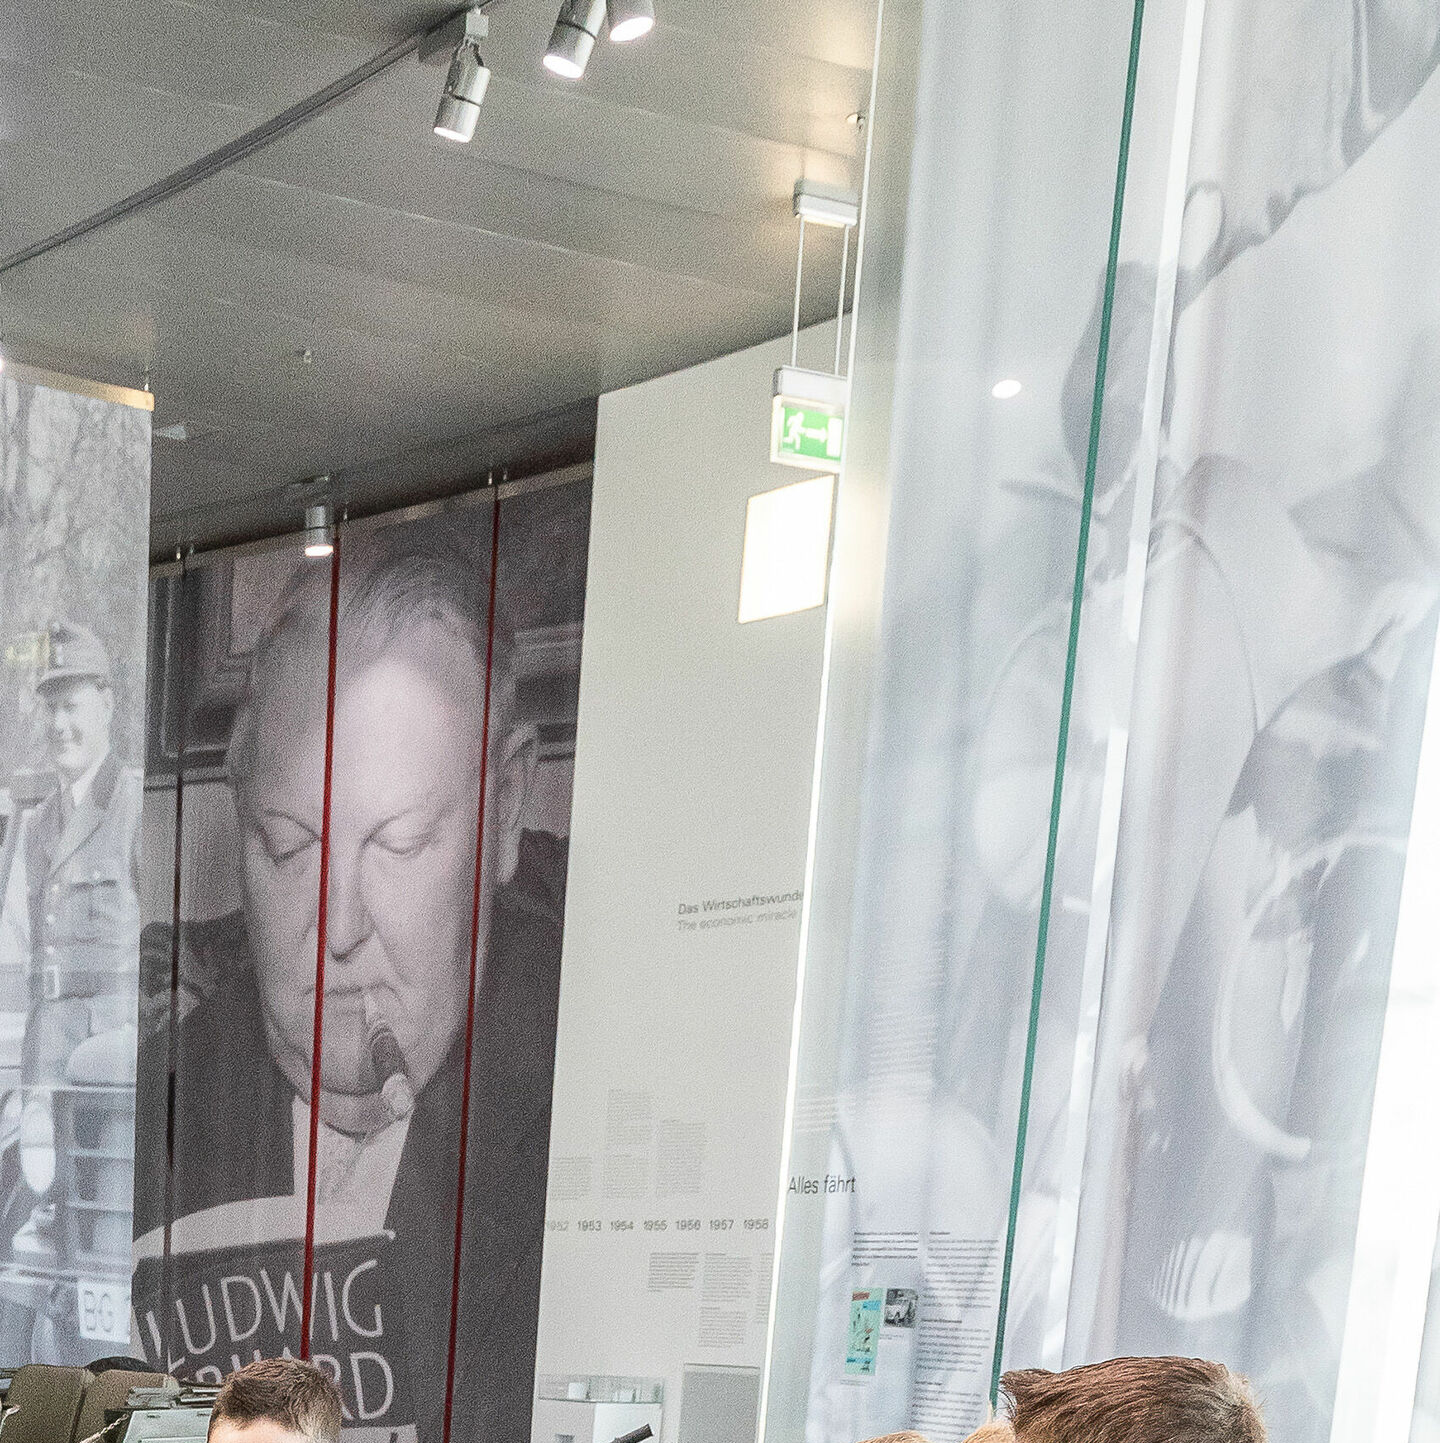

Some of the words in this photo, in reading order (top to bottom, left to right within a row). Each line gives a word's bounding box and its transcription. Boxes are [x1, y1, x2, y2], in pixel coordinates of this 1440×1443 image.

[677, 902, 699, 915] Das
[787, 1176, 819, 1194] Alles
[823, 1174, 857, 1193] fährt
[577, 1220, 601, 1231] 1953
[610, 1220, 634, 1231] 1954
[709, 1219, 734, 1230] 1957
[145, 1258, 384, 1374] LUDWIG
